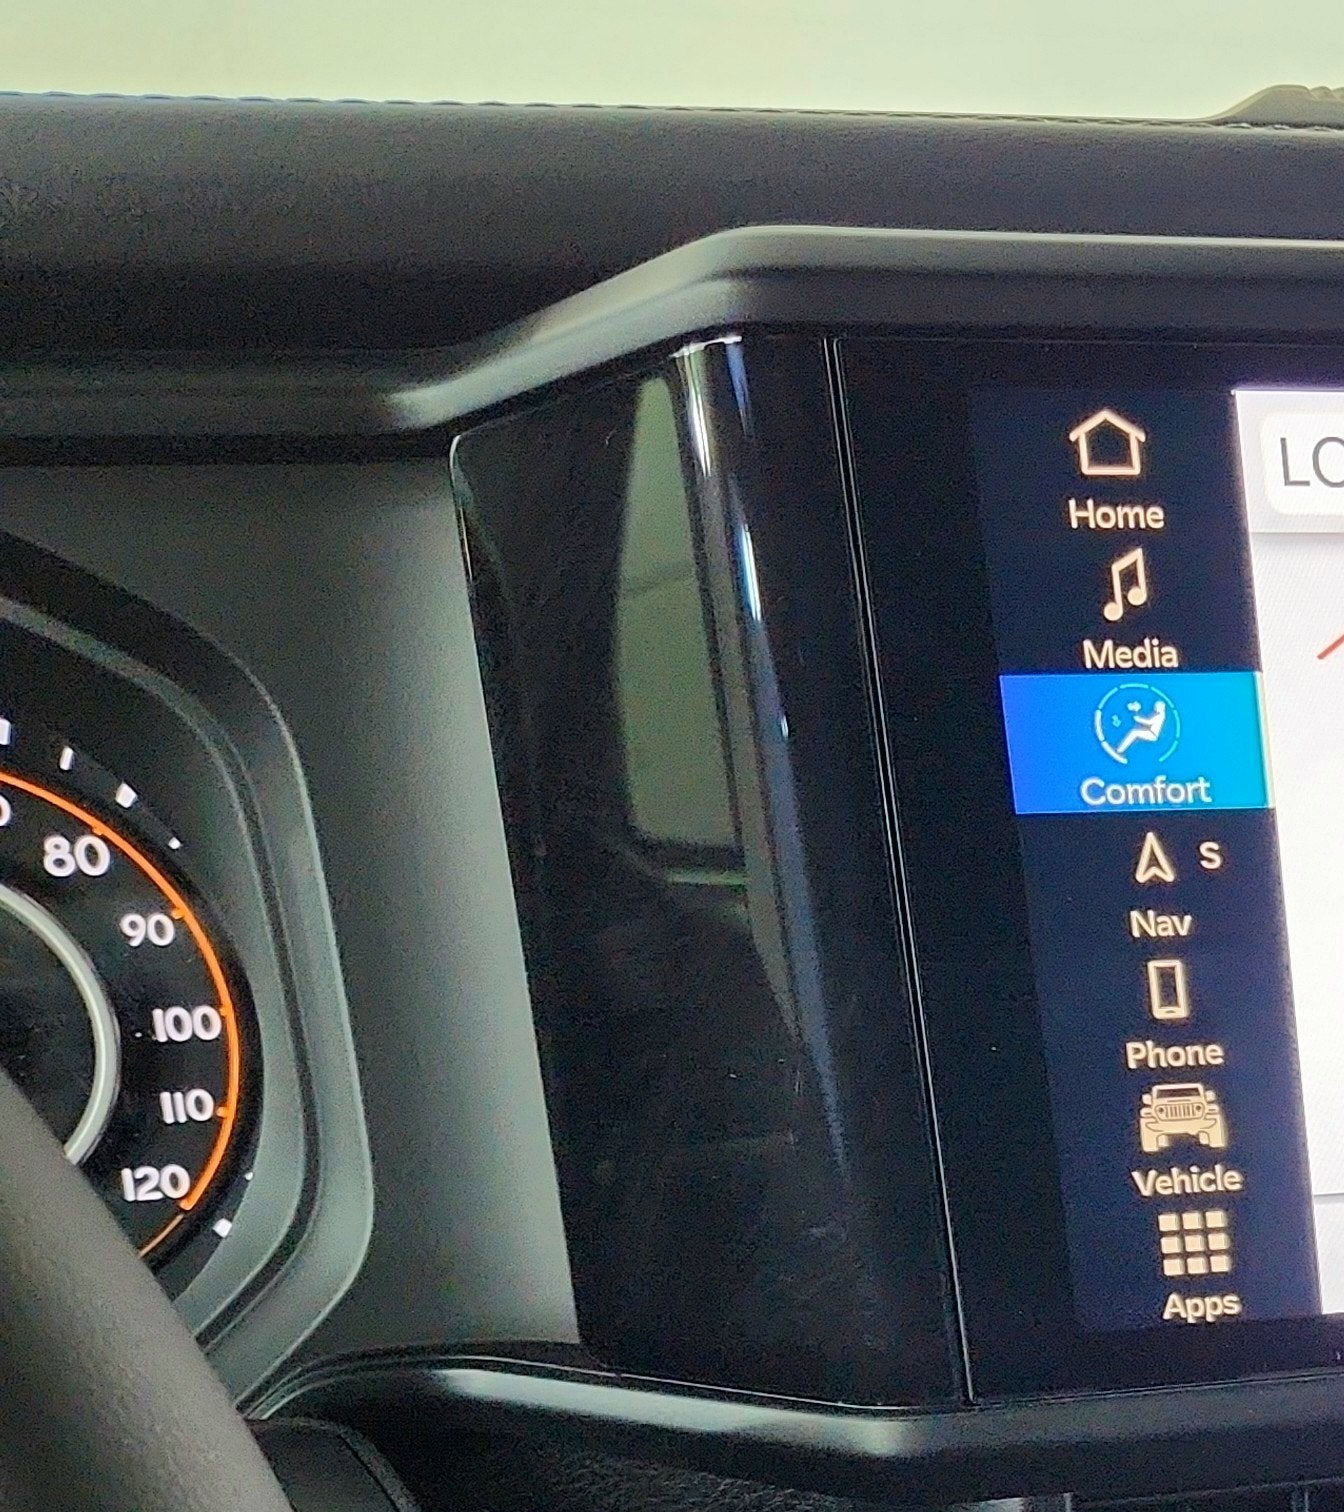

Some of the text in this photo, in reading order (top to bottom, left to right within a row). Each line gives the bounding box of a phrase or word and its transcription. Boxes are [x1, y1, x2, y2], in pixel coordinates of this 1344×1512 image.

[1068, 498, 1165, 530] Home
[1083, 640, 1179, 670] Media
[1081, 777, 1212, 806] Comfort
[43, 834, 111, 878] 80
[1199, 842, 1222, 870] S
[119, 912, 176, 948] 90
[1130, 910, 1191, 938] Nav
[152, 1005, 223, 1043] 100
[1126, 1040, 1225, 1070] Phone
[159, 1088, 216, 1125] 110
[121, 1163, 191, 1203] 120
[1132, 1165, 1243, 1196] Vehicle
[1163, 1291, 1242, 1323] Apps
